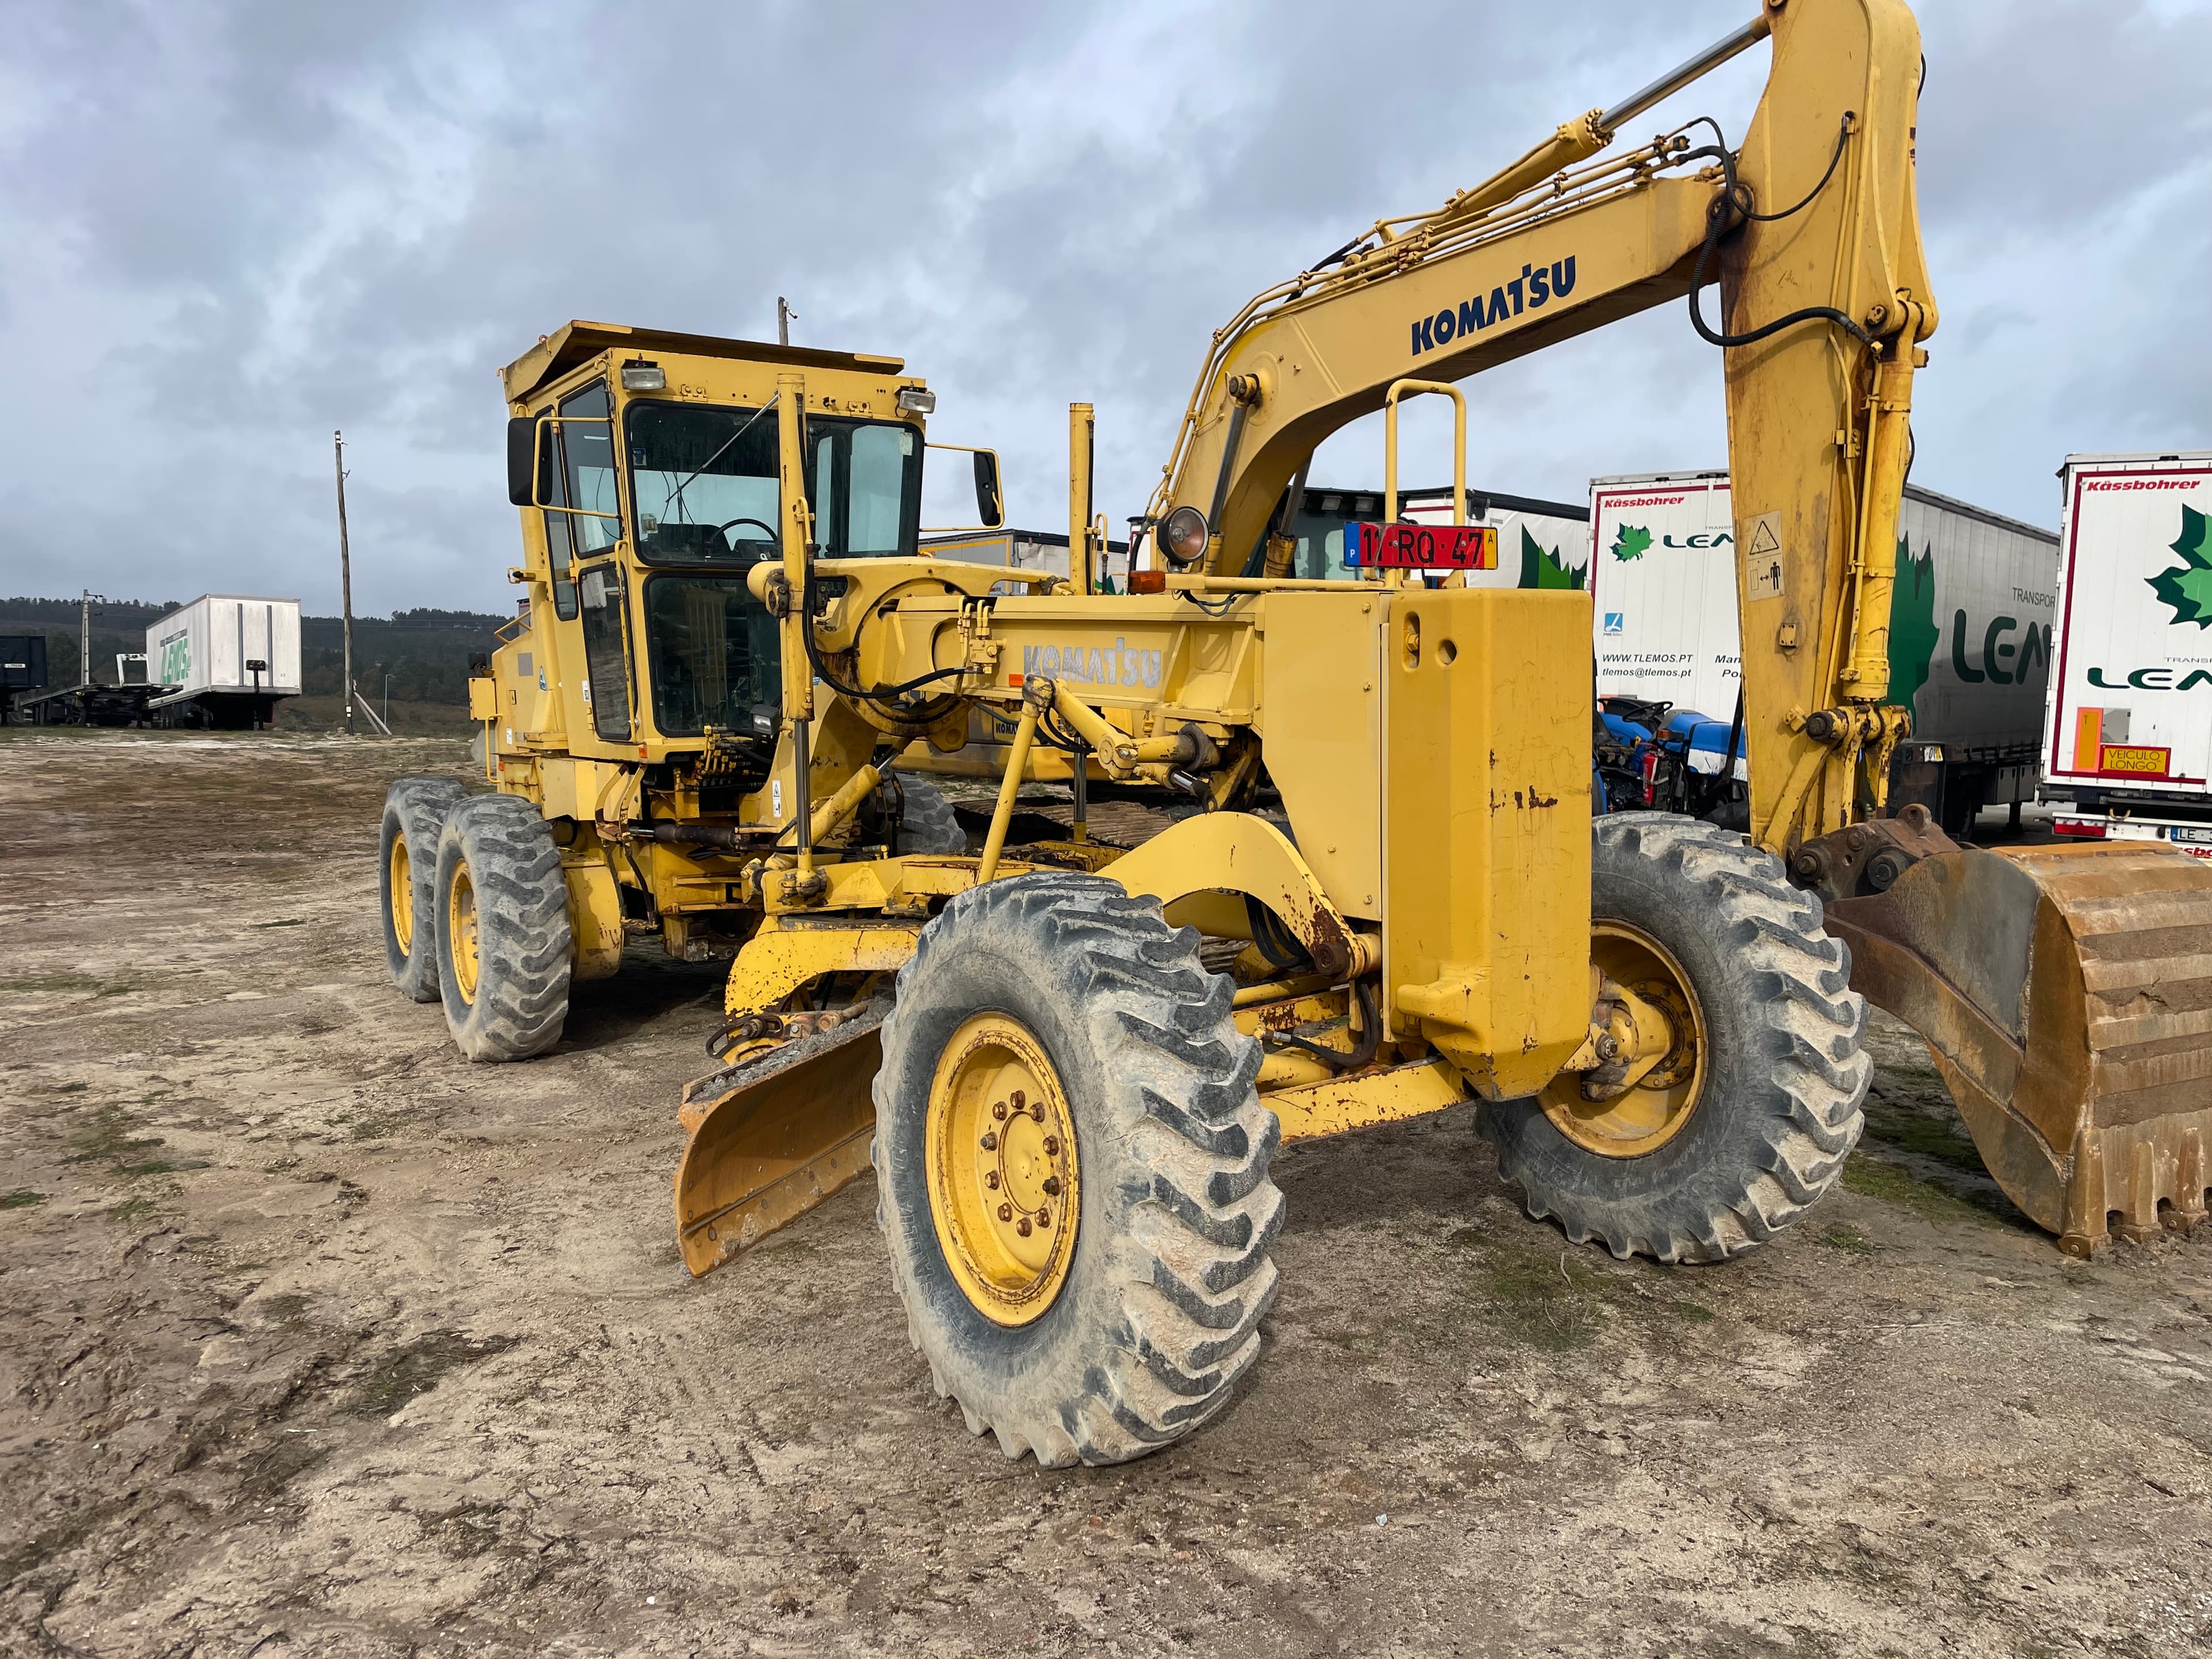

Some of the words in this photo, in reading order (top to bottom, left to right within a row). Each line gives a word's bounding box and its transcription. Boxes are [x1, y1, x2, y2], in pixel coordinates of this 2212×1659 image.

[1411, 255, 1575, 356] KOMATSU
[2086, 480, 2200, 491] Kässbohrer
[1604, 497, 1684, 507] Kässbohrer
[1024, 637, 1161, 688] KOMATSU
[1603, 654, 1693, 663] WWW.TLEMOS.PT
[1603, 668, 1691, 678] tlemos@tlemos.pt
[1722, 669, 1741, 677] Po
[996, 724, 1018, 734] KOMA
[2109, 749, 2160, 760] VEICULO
[2111, 760, 2157, 771] LONGO
